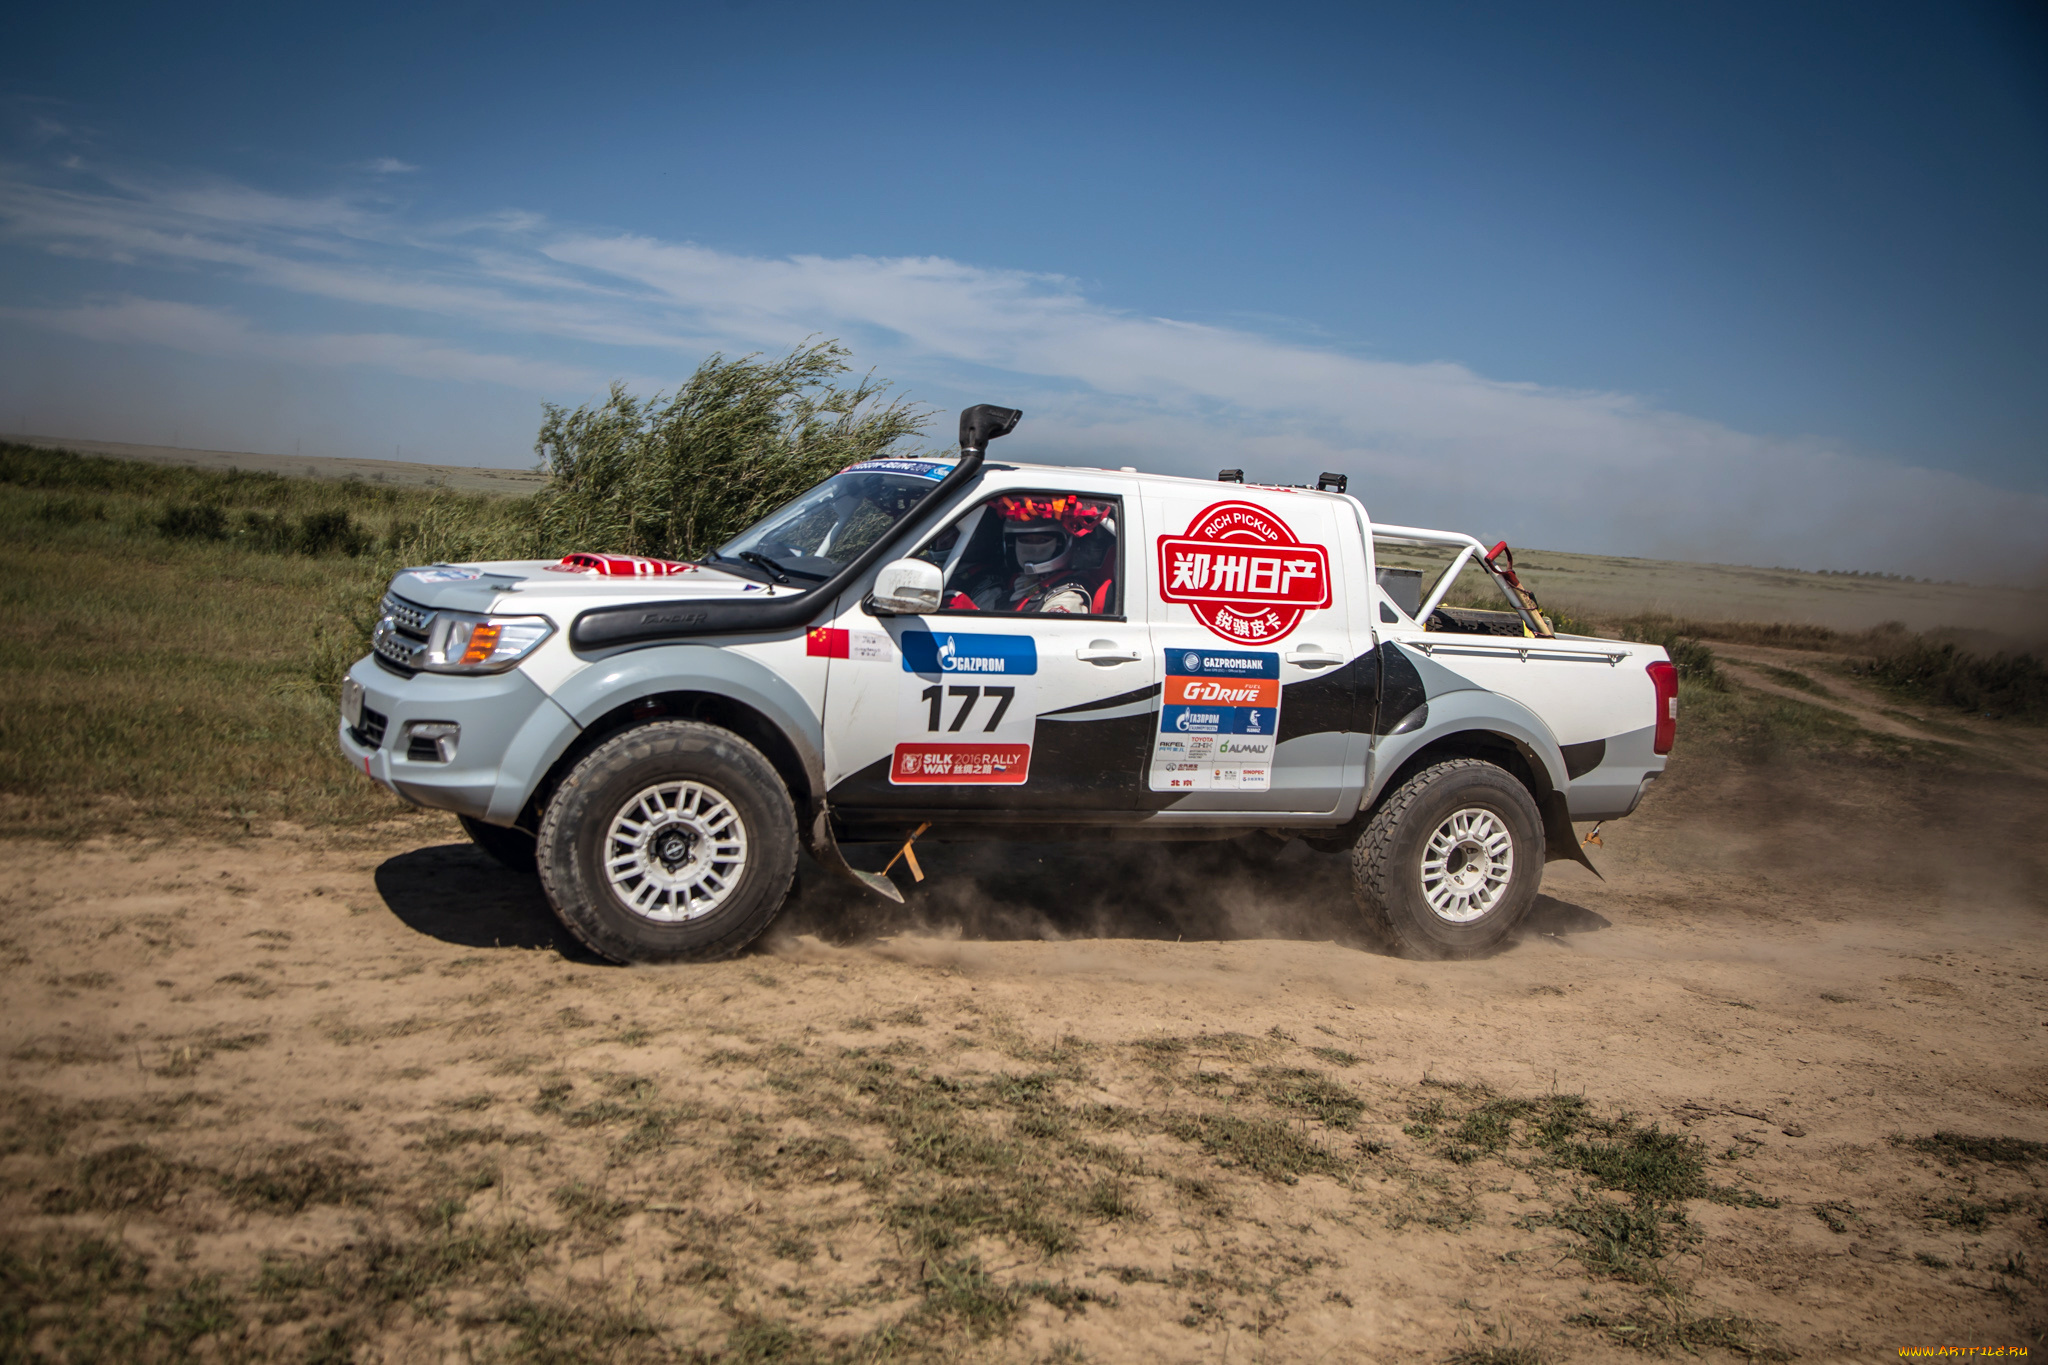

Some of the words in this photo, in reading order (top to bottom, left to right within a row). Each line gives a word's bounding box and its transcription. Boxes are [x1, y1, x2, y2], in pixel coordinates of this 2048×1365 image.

[1204, 513, 1233, 539] RICH
[1233, 512, 1278, 541] PICKUP
[1170, 551, 1317, 595] 郑州日产
[1214, 608, 1282, 638] 锐骐皮卡
[956, 656, 1005, 673] GAZPROM
[1203, 657, 1263, 669] GAZPROMBANK
[921, 684, 1016, 733] 177
[1189, 713, 1220, 724] ГАЗПРОМ
[1228, 744, 1269, 754] ALMALY
[923, 753, 953, 764] SILK
[954, 753, 982, 764] 2016
[982, 753, 1021, 765] RALLY
[923, 764, 950, 774] WAY
[1170, 779, 1193, 787] 北京
